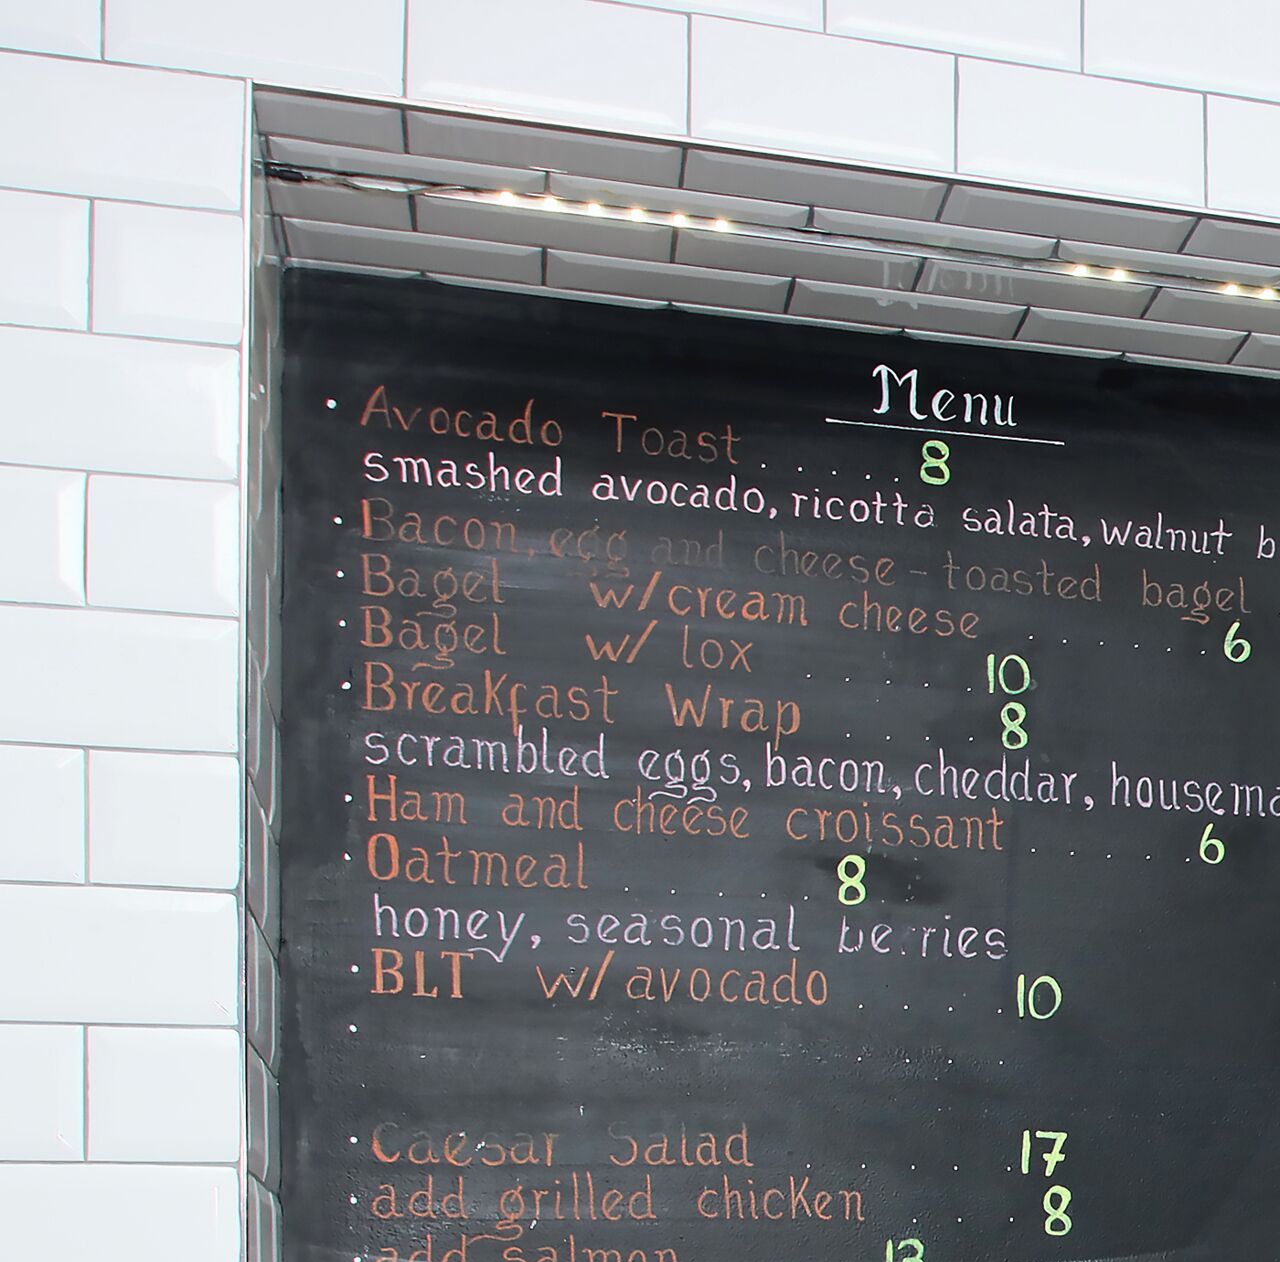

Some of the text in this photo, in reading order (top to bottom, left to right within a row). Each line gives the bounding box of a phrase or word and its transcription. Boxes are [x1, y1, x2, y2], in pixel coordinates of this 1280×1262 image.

[361, 386, 951, 486] Avocado Toast 8
[872, 364, 1017, 427] Menu
[364, 451, 563, 498] smashed
[792, 490, 935, 529] ricotta
[1100, 513, 1233, 556] walnut
[361, 553, 1252, 663] Bagel cheese 6
[652, 528, 724, 570] and
[1142, 569, 1252, 624] bagel
[361, 605, 1031, 696] Bagel w/ lox 10
[362, 661, 1028, 751] Breakfast Wrap 8
[364, 727, 610, 780] scrambled
[765, 742, 902, 800] bacon,
[914, 749, 1094, 812] cheddar,
[367, 774, 1225, 865] Ham and cheese croissant 6
[367, 832, 867, 906] Oatmeal 8
[373, 893, 800, 963] honey, seasonal
[371, 948, 1062, 1020] BLT 10
[370, 1121, 1068, 1178] Caesar Salad 17
[370, 1170, 1074, 1245] add grilled chicken 8
